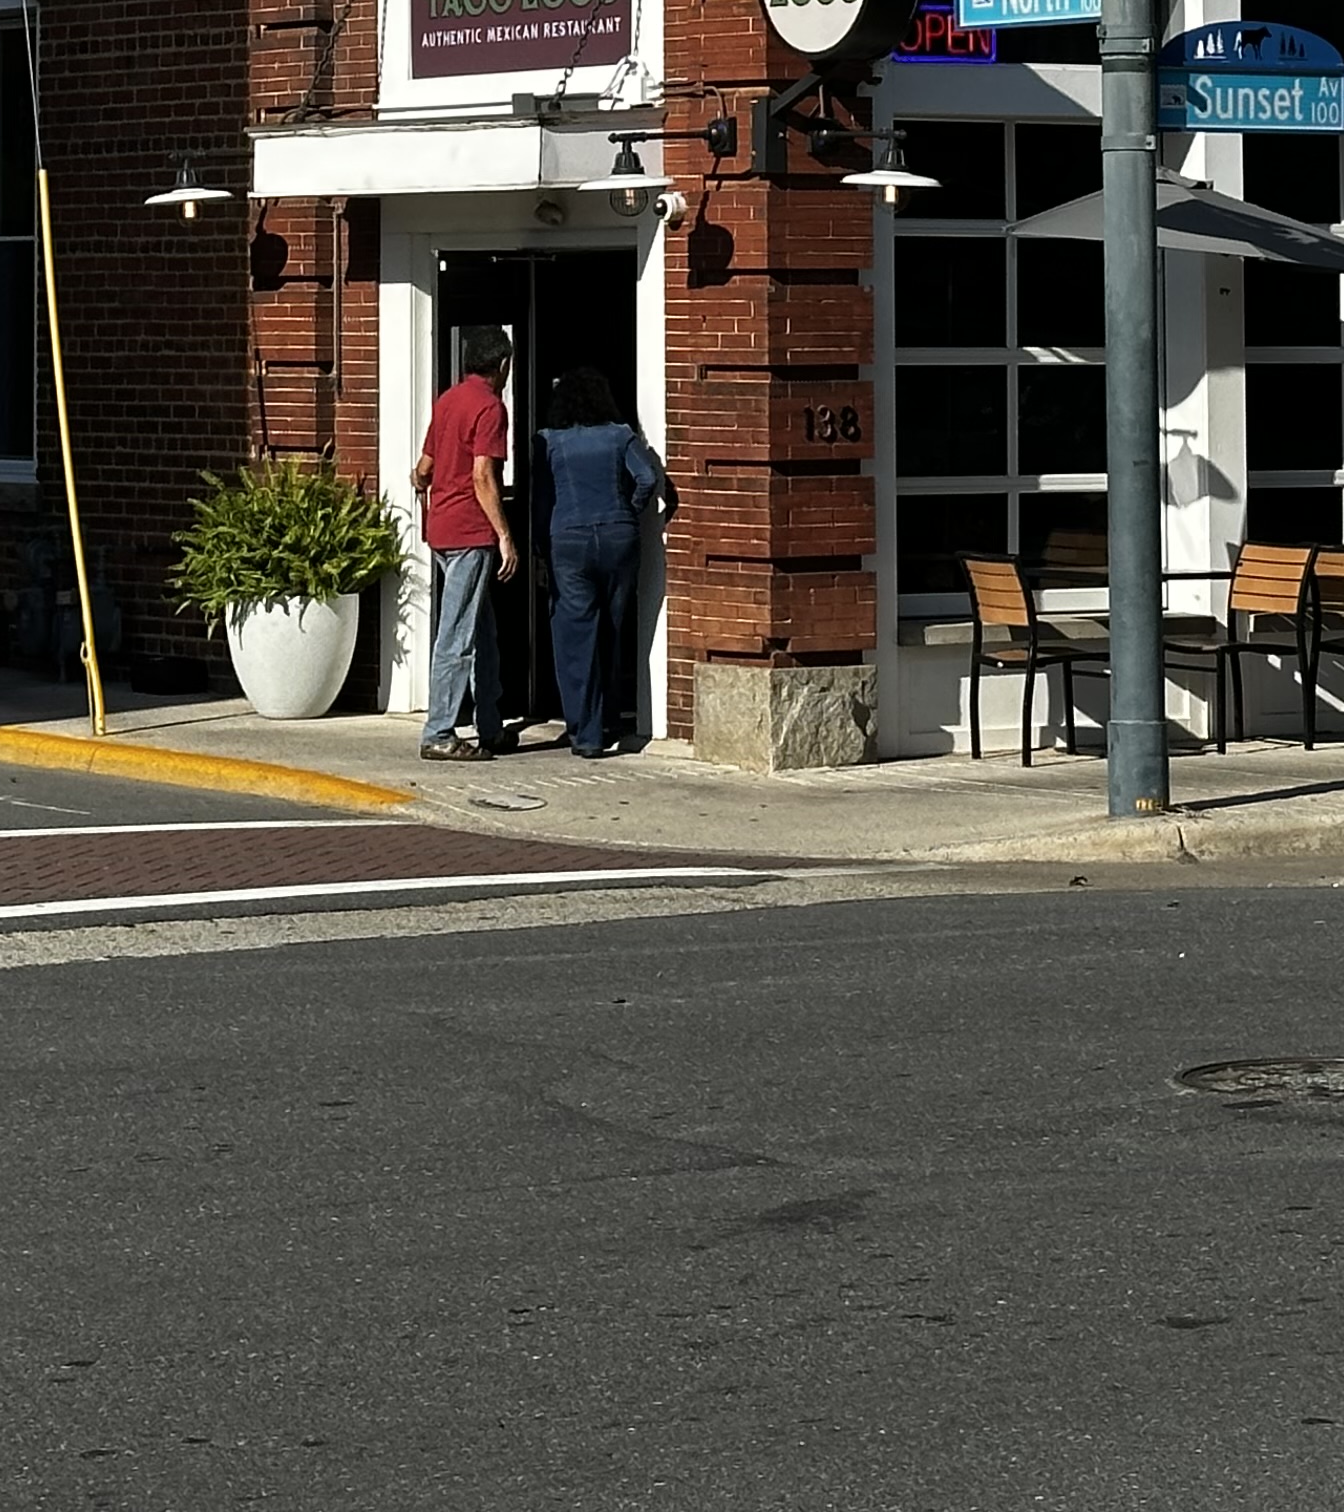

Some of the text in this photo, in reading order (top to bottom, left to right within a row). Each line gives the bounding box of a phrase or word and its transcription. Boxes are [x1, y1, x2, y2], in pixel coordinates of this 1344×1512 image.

[421, 28, 482, 48] AUTHENTIC
[487, 23, 539, 43] MEXICAN
[1194, 75, 1304, 121] Sunset
[1311, 102, 1340, 124] 100
[803, 404, 862, 443] 138
